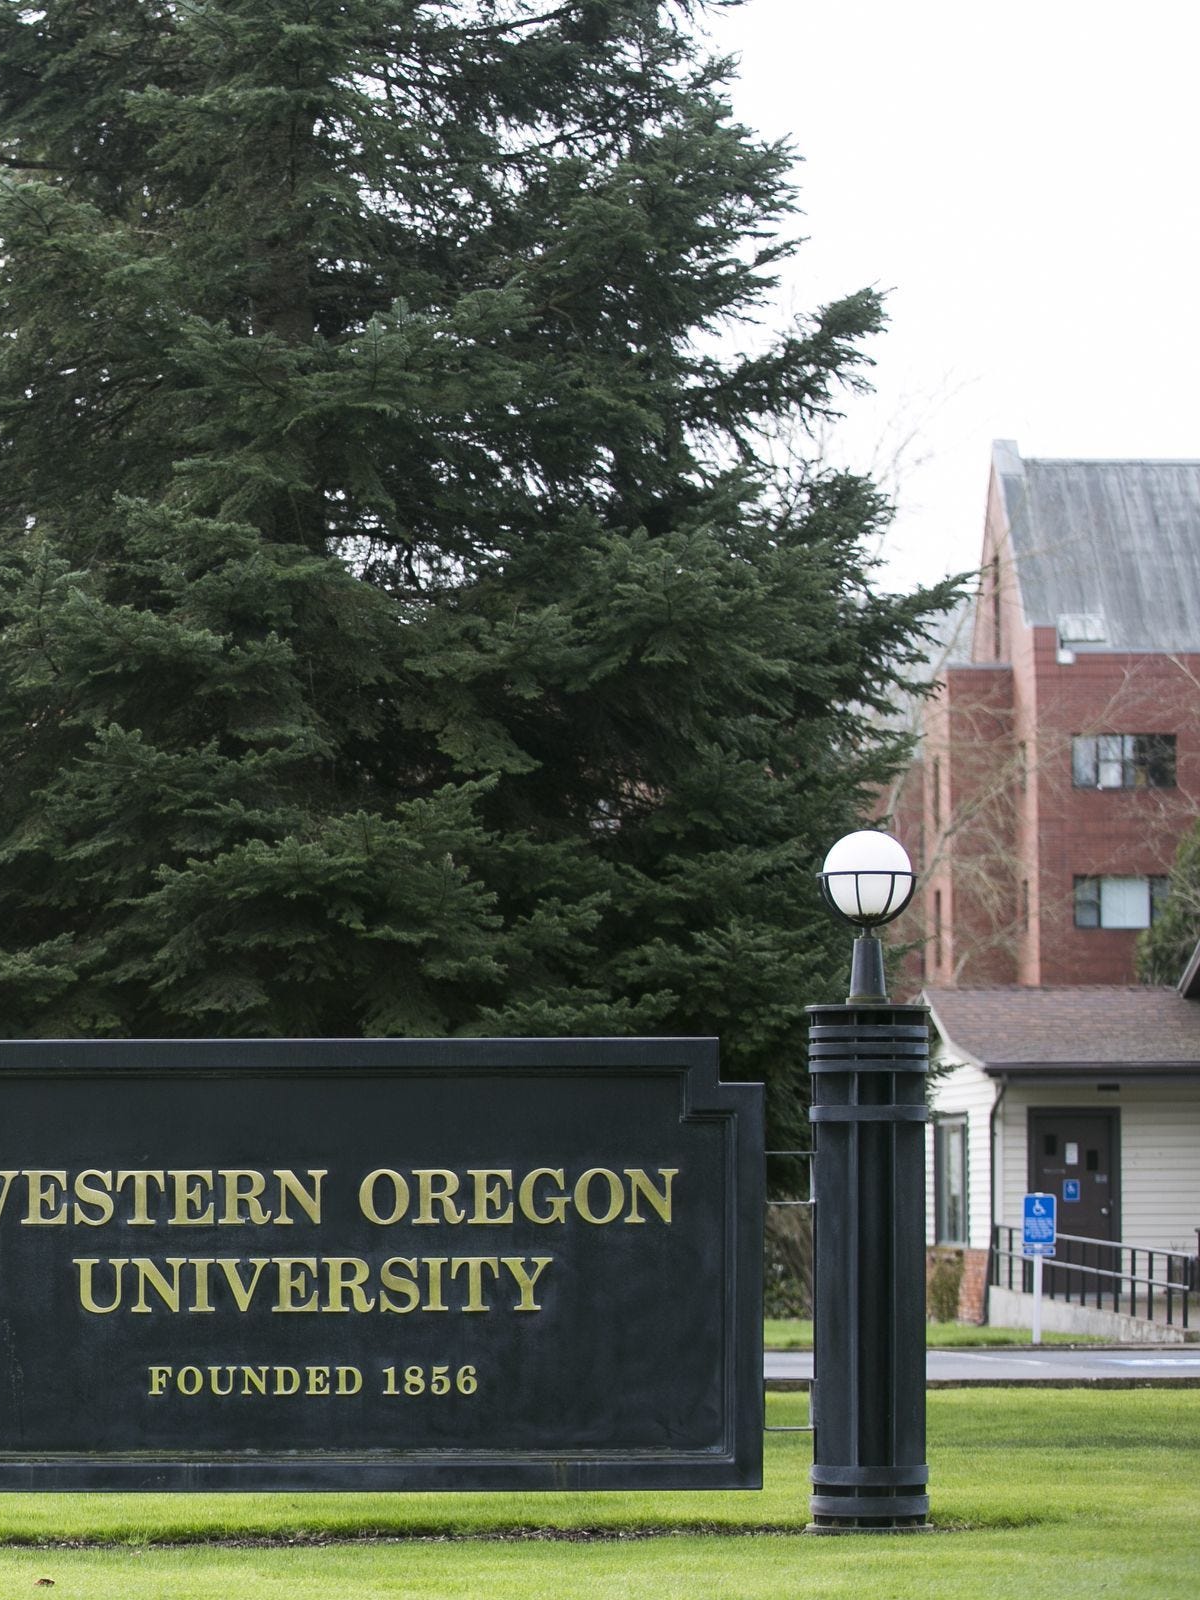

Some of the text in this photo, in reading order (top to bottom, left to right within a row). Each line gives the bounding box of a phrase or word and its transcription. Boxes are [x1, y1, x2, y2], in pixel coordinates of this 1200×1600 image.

[359, 1168, 678, 1226] OREGON
[73, 1256, 553, 1315] UNIVERSITY
[148, 1366, 479, 1396] FOUNDED 1856
